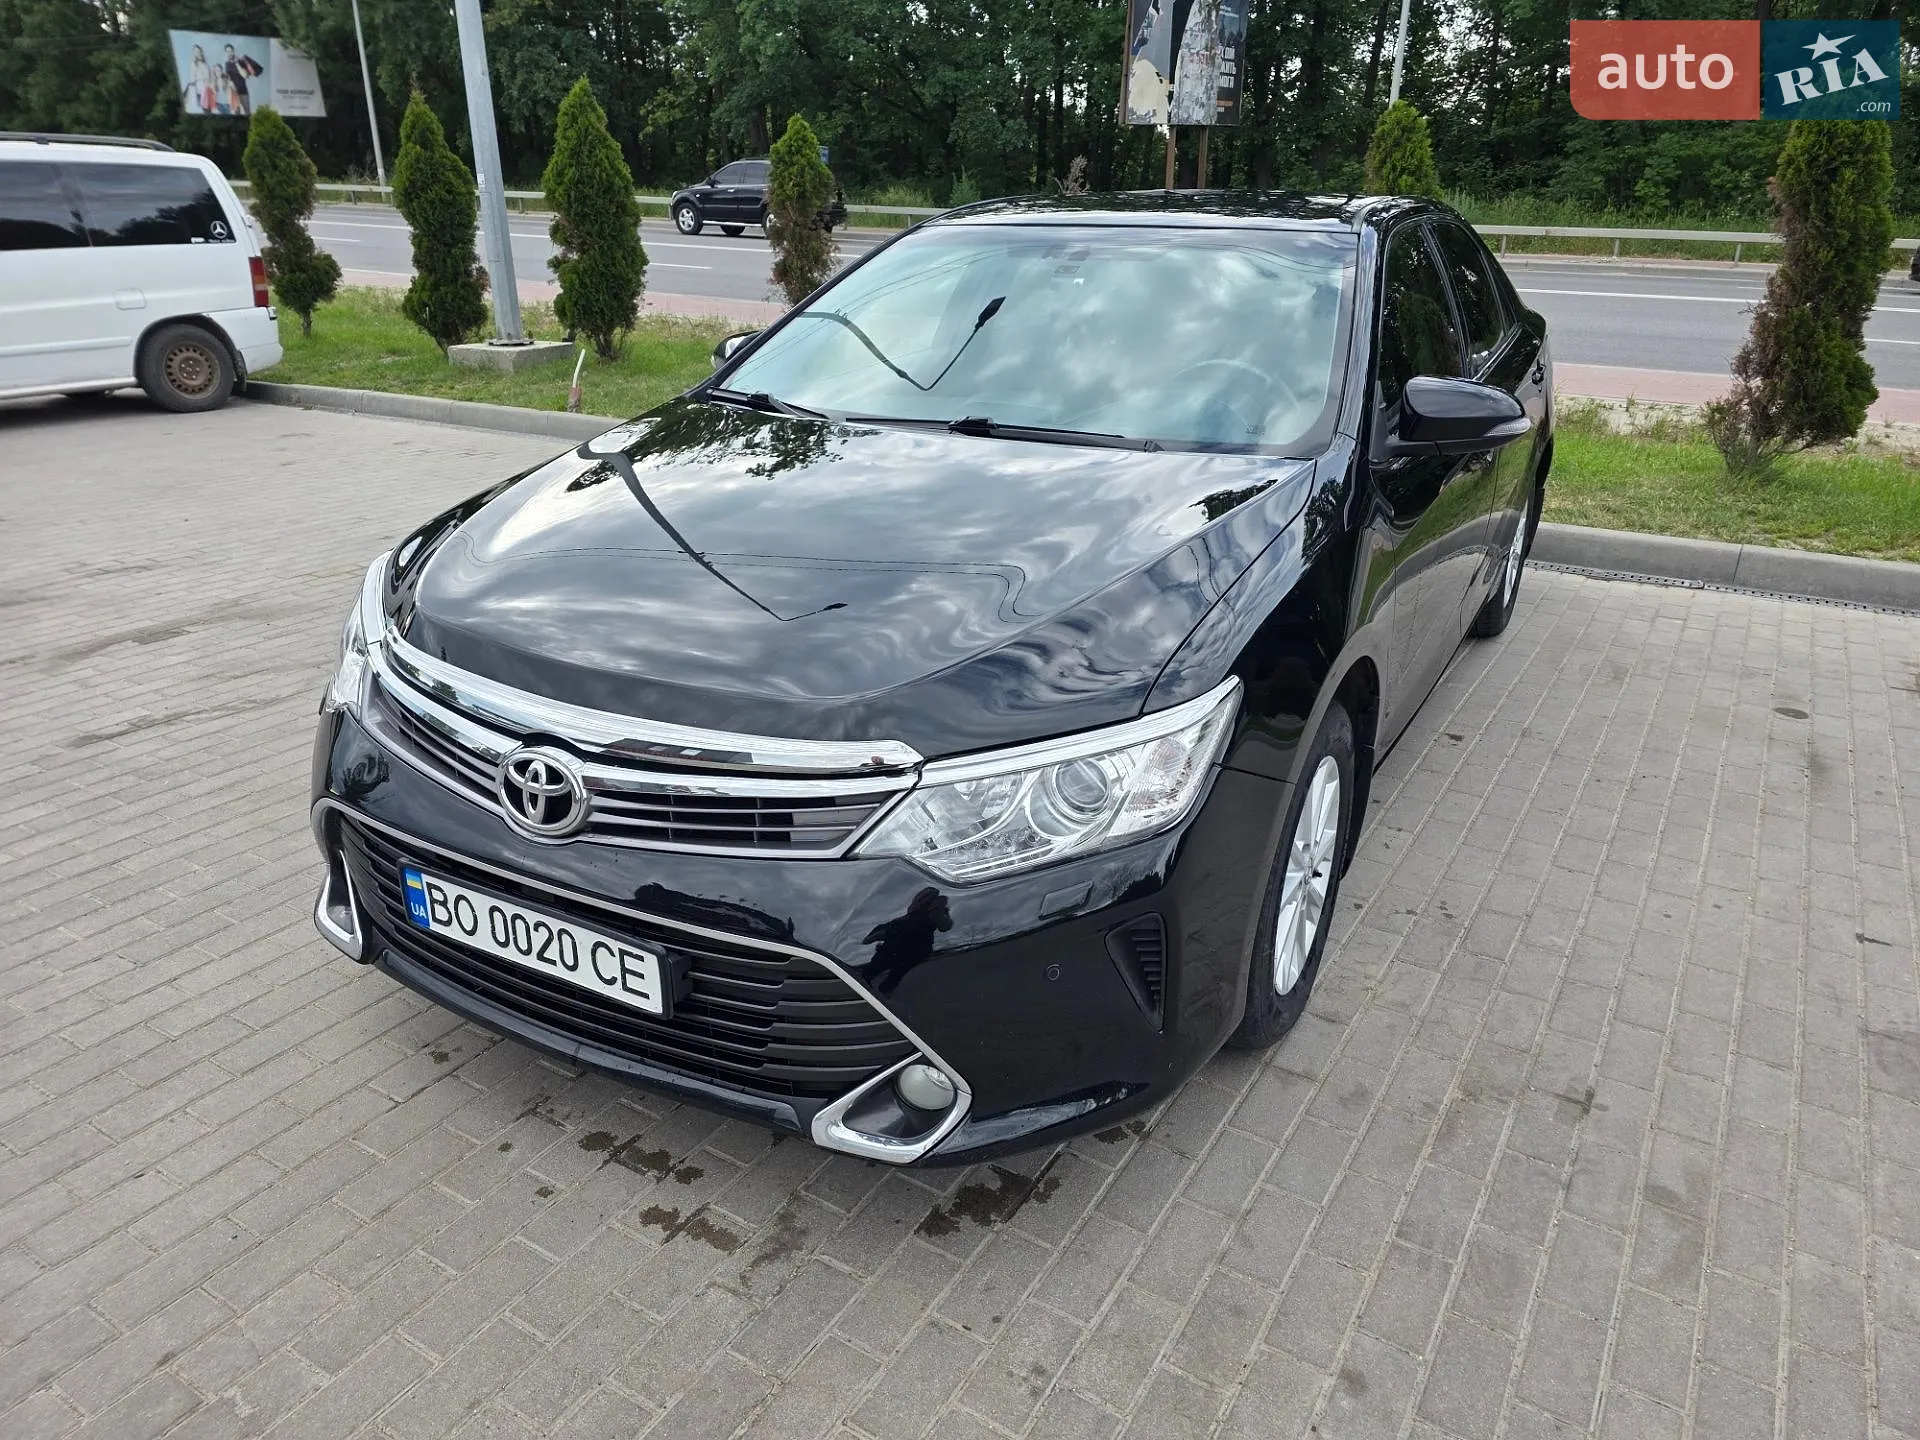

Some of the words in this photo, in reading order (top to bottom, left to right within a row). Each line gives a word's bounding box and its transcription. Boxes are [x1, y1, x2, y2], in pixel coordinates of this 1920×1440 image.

[410, 901, 427, 919] UA
[425, 881, 478, 937] BO
[488, 904, 579, 972] 0020
[591, 940, 650, 1000] CE
